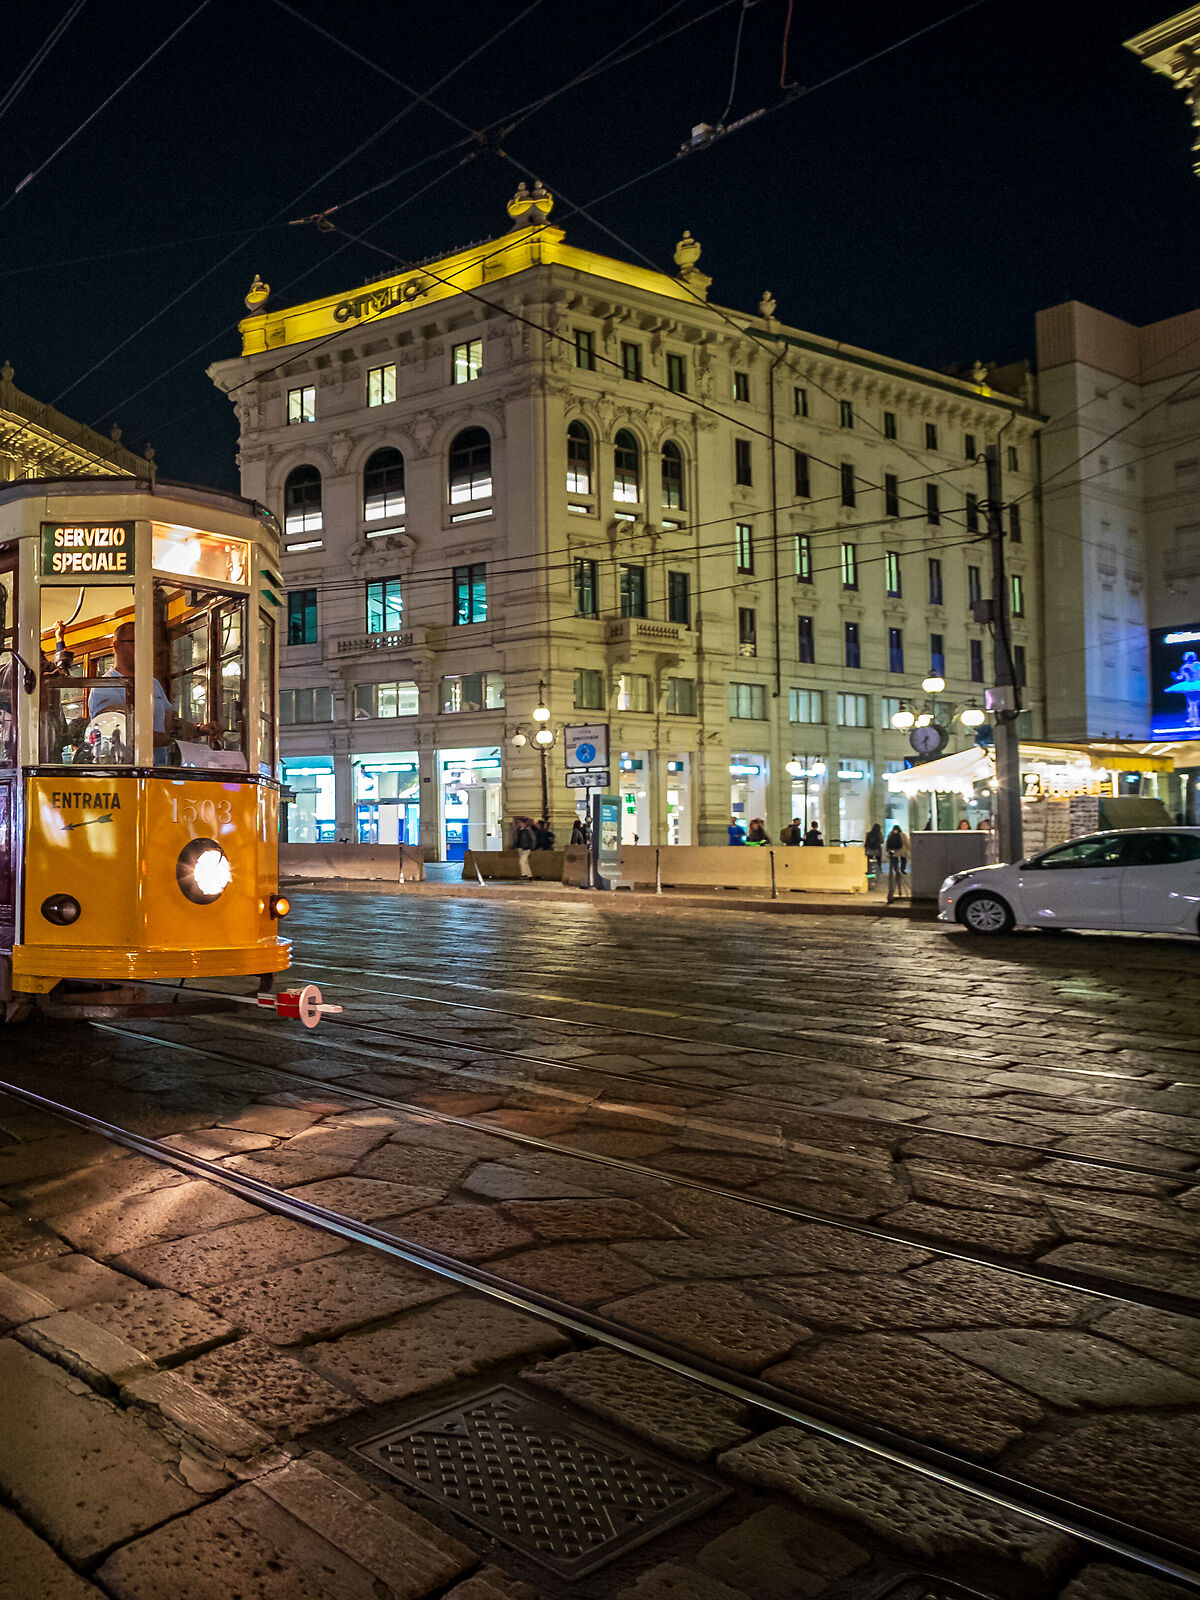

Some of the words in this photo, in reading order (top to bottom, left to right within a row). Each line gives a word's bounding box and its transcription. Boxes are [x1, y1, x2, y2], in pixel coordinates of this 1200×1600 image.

[54, 527, 126, 547] SERVIZIO
[52, 552, 127, 573] SPECIALE
[52, 792, 121, 809] ENTRATA
[172, 798, 233, 824] 1503
